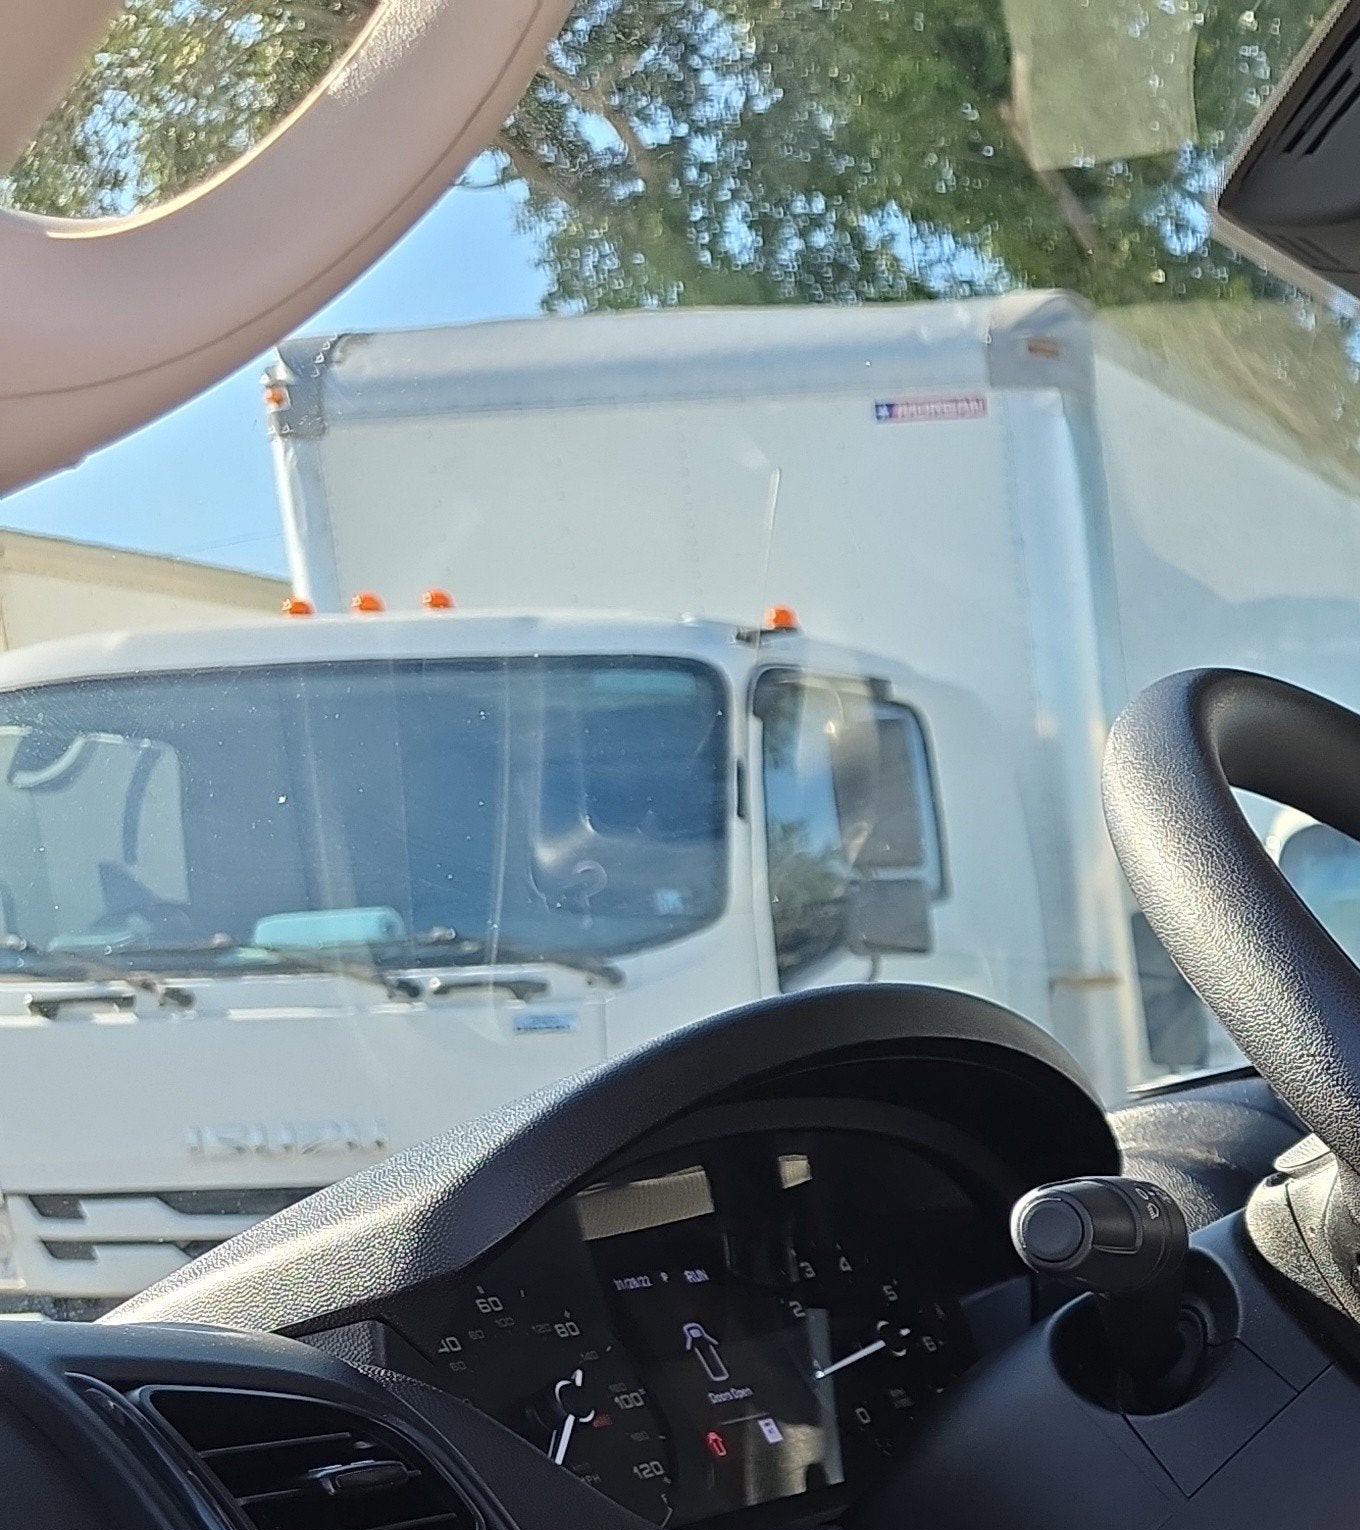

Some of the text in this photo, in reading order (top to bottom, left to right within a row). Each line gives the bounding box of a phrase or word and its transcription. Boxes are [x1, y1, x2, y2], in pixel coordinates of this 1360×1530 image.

[800, 1261, 816, 1278] 3
[840, 1256, 852, 1272] 4
[883, 1285, 898, 1301] 5
[475, 1297, 503, 1313] 60
[789, 1301, 806, 1318] 2
[554, 1322, 580, 1338] 80
[922, 1336, 937, 1351] 6
[614, 1392, 644, 1409] 100
[855, 1407, 871, 1424] 0
[633, 1461, 664, 1480] 120
